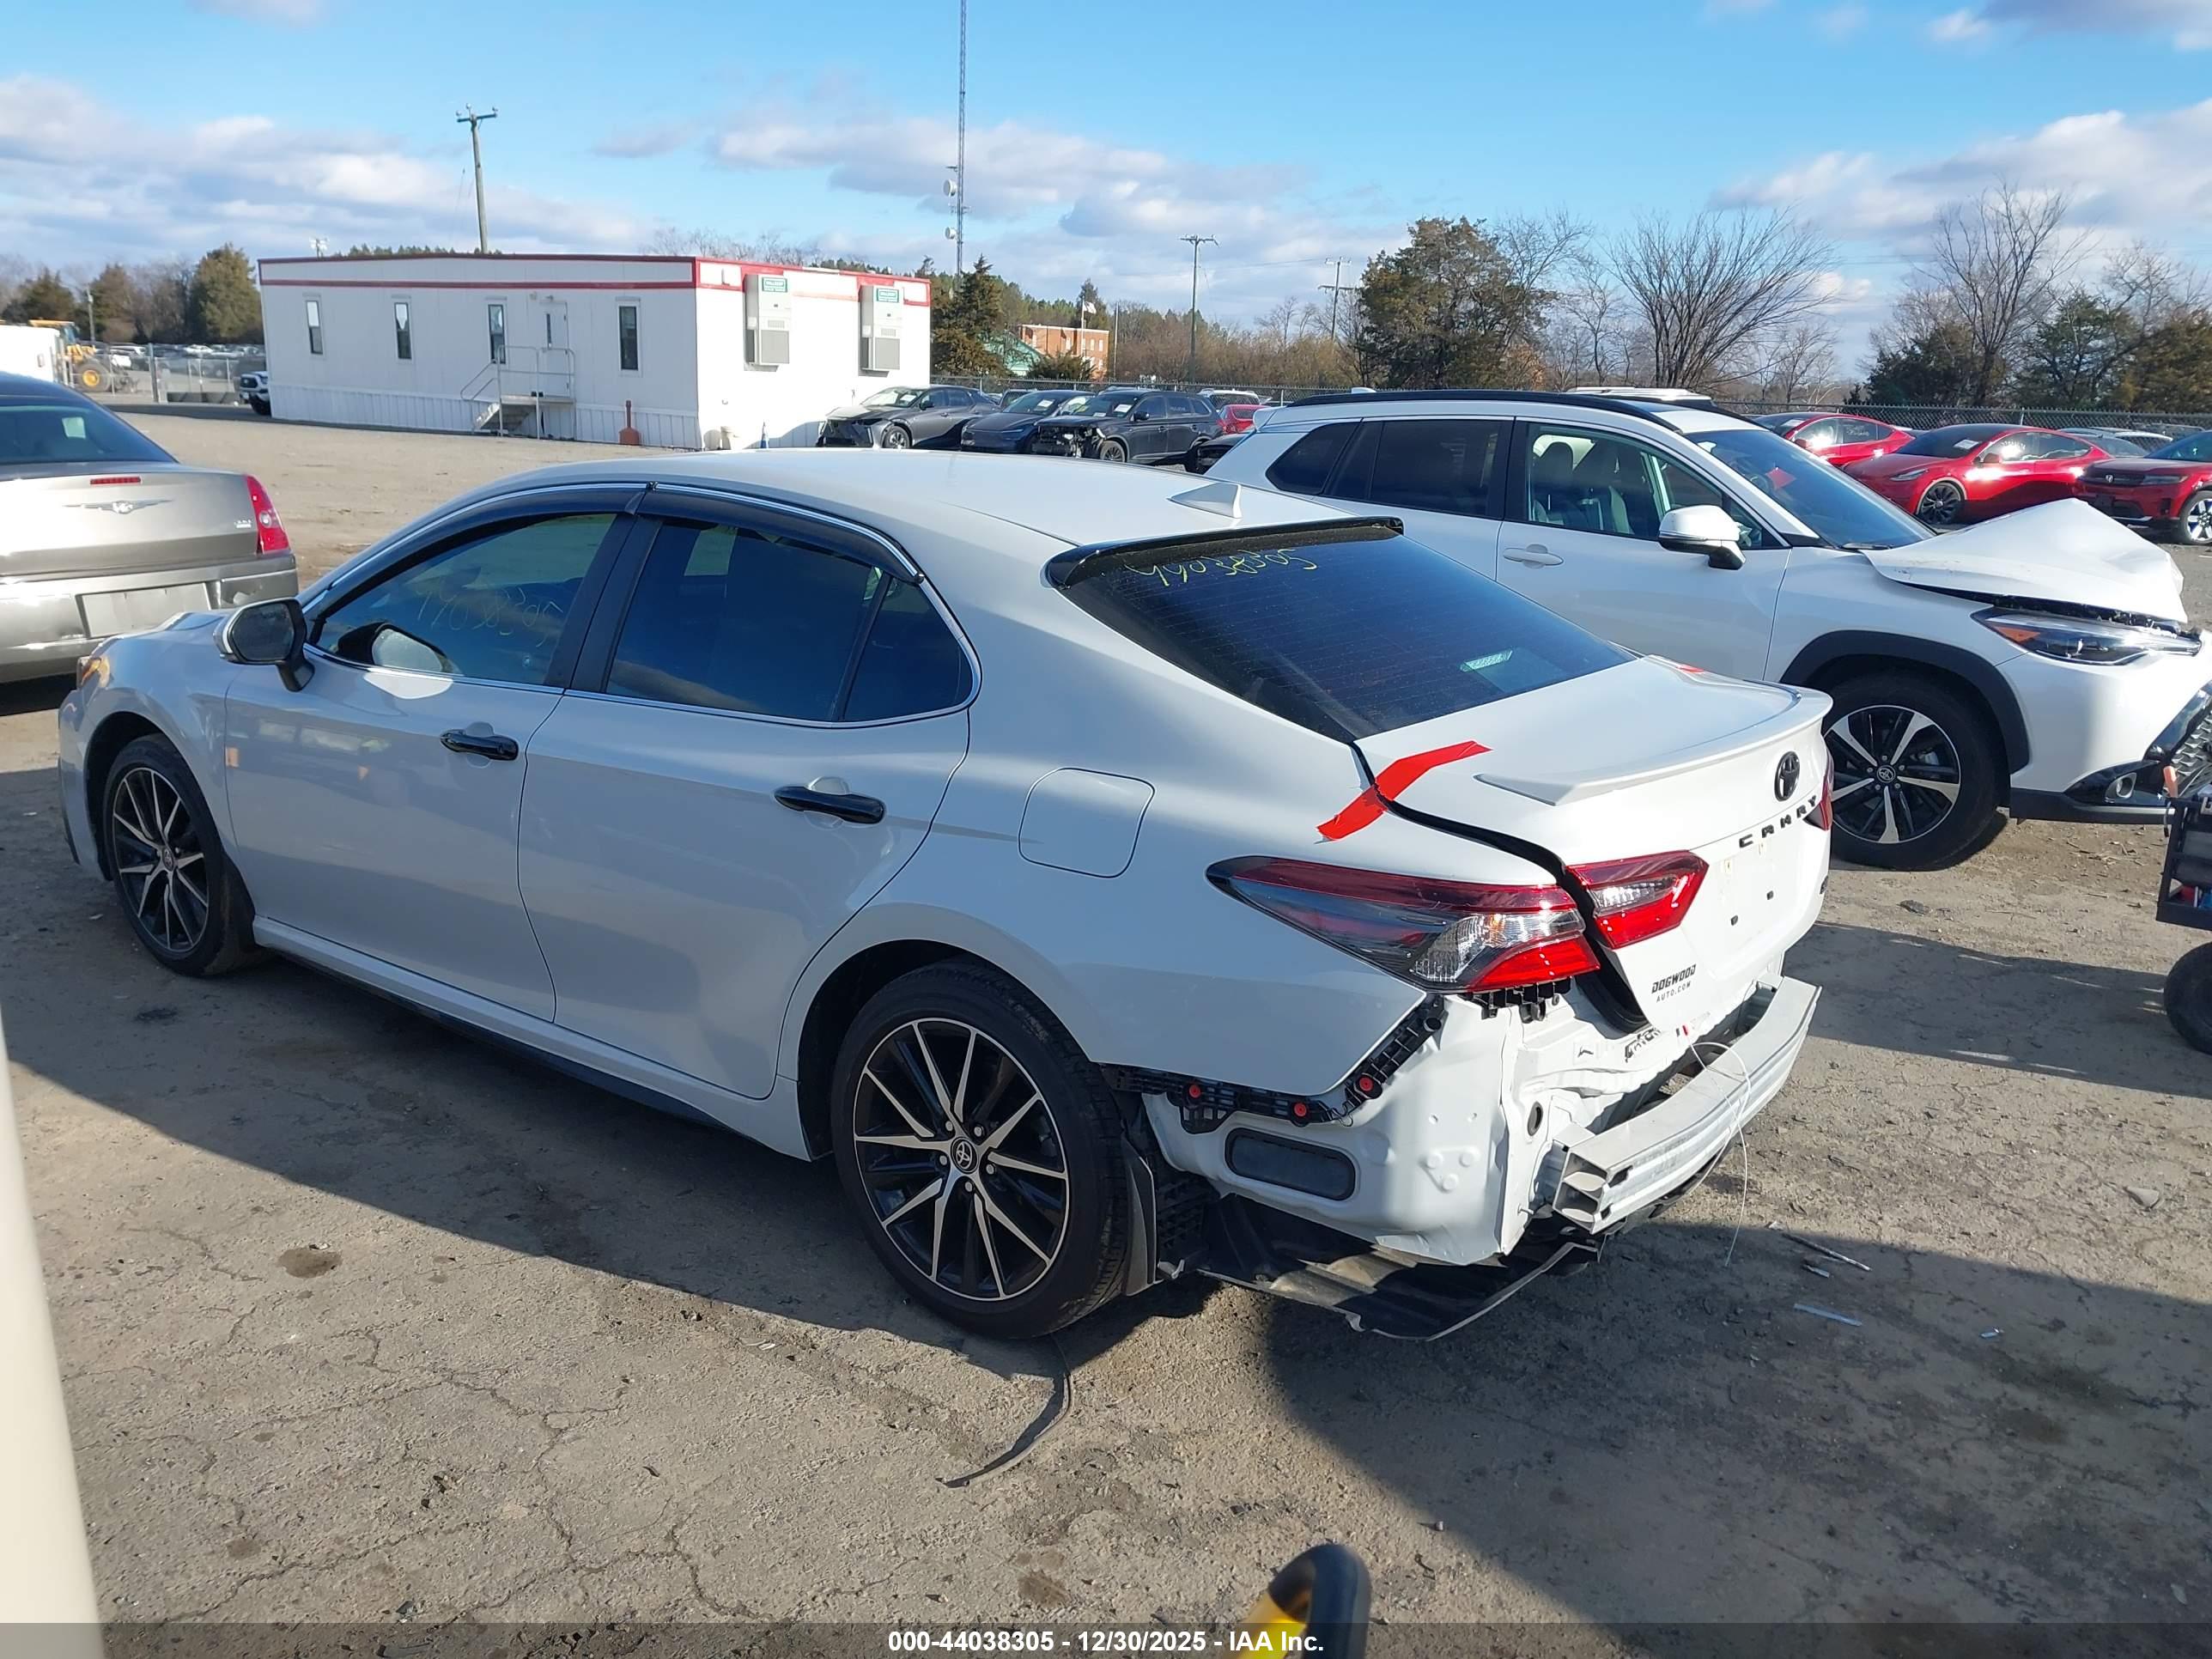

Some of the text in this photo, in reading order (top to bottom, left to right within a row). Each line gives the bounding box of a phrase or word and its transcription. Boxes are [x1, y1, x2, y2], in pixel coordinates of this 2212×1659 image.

[1739, 795, 1817, 848] CAMRY
[1651, 963, 1697, 994] DOGWOOD
[1656, 981, 1692, 1003] AUTO.COM
